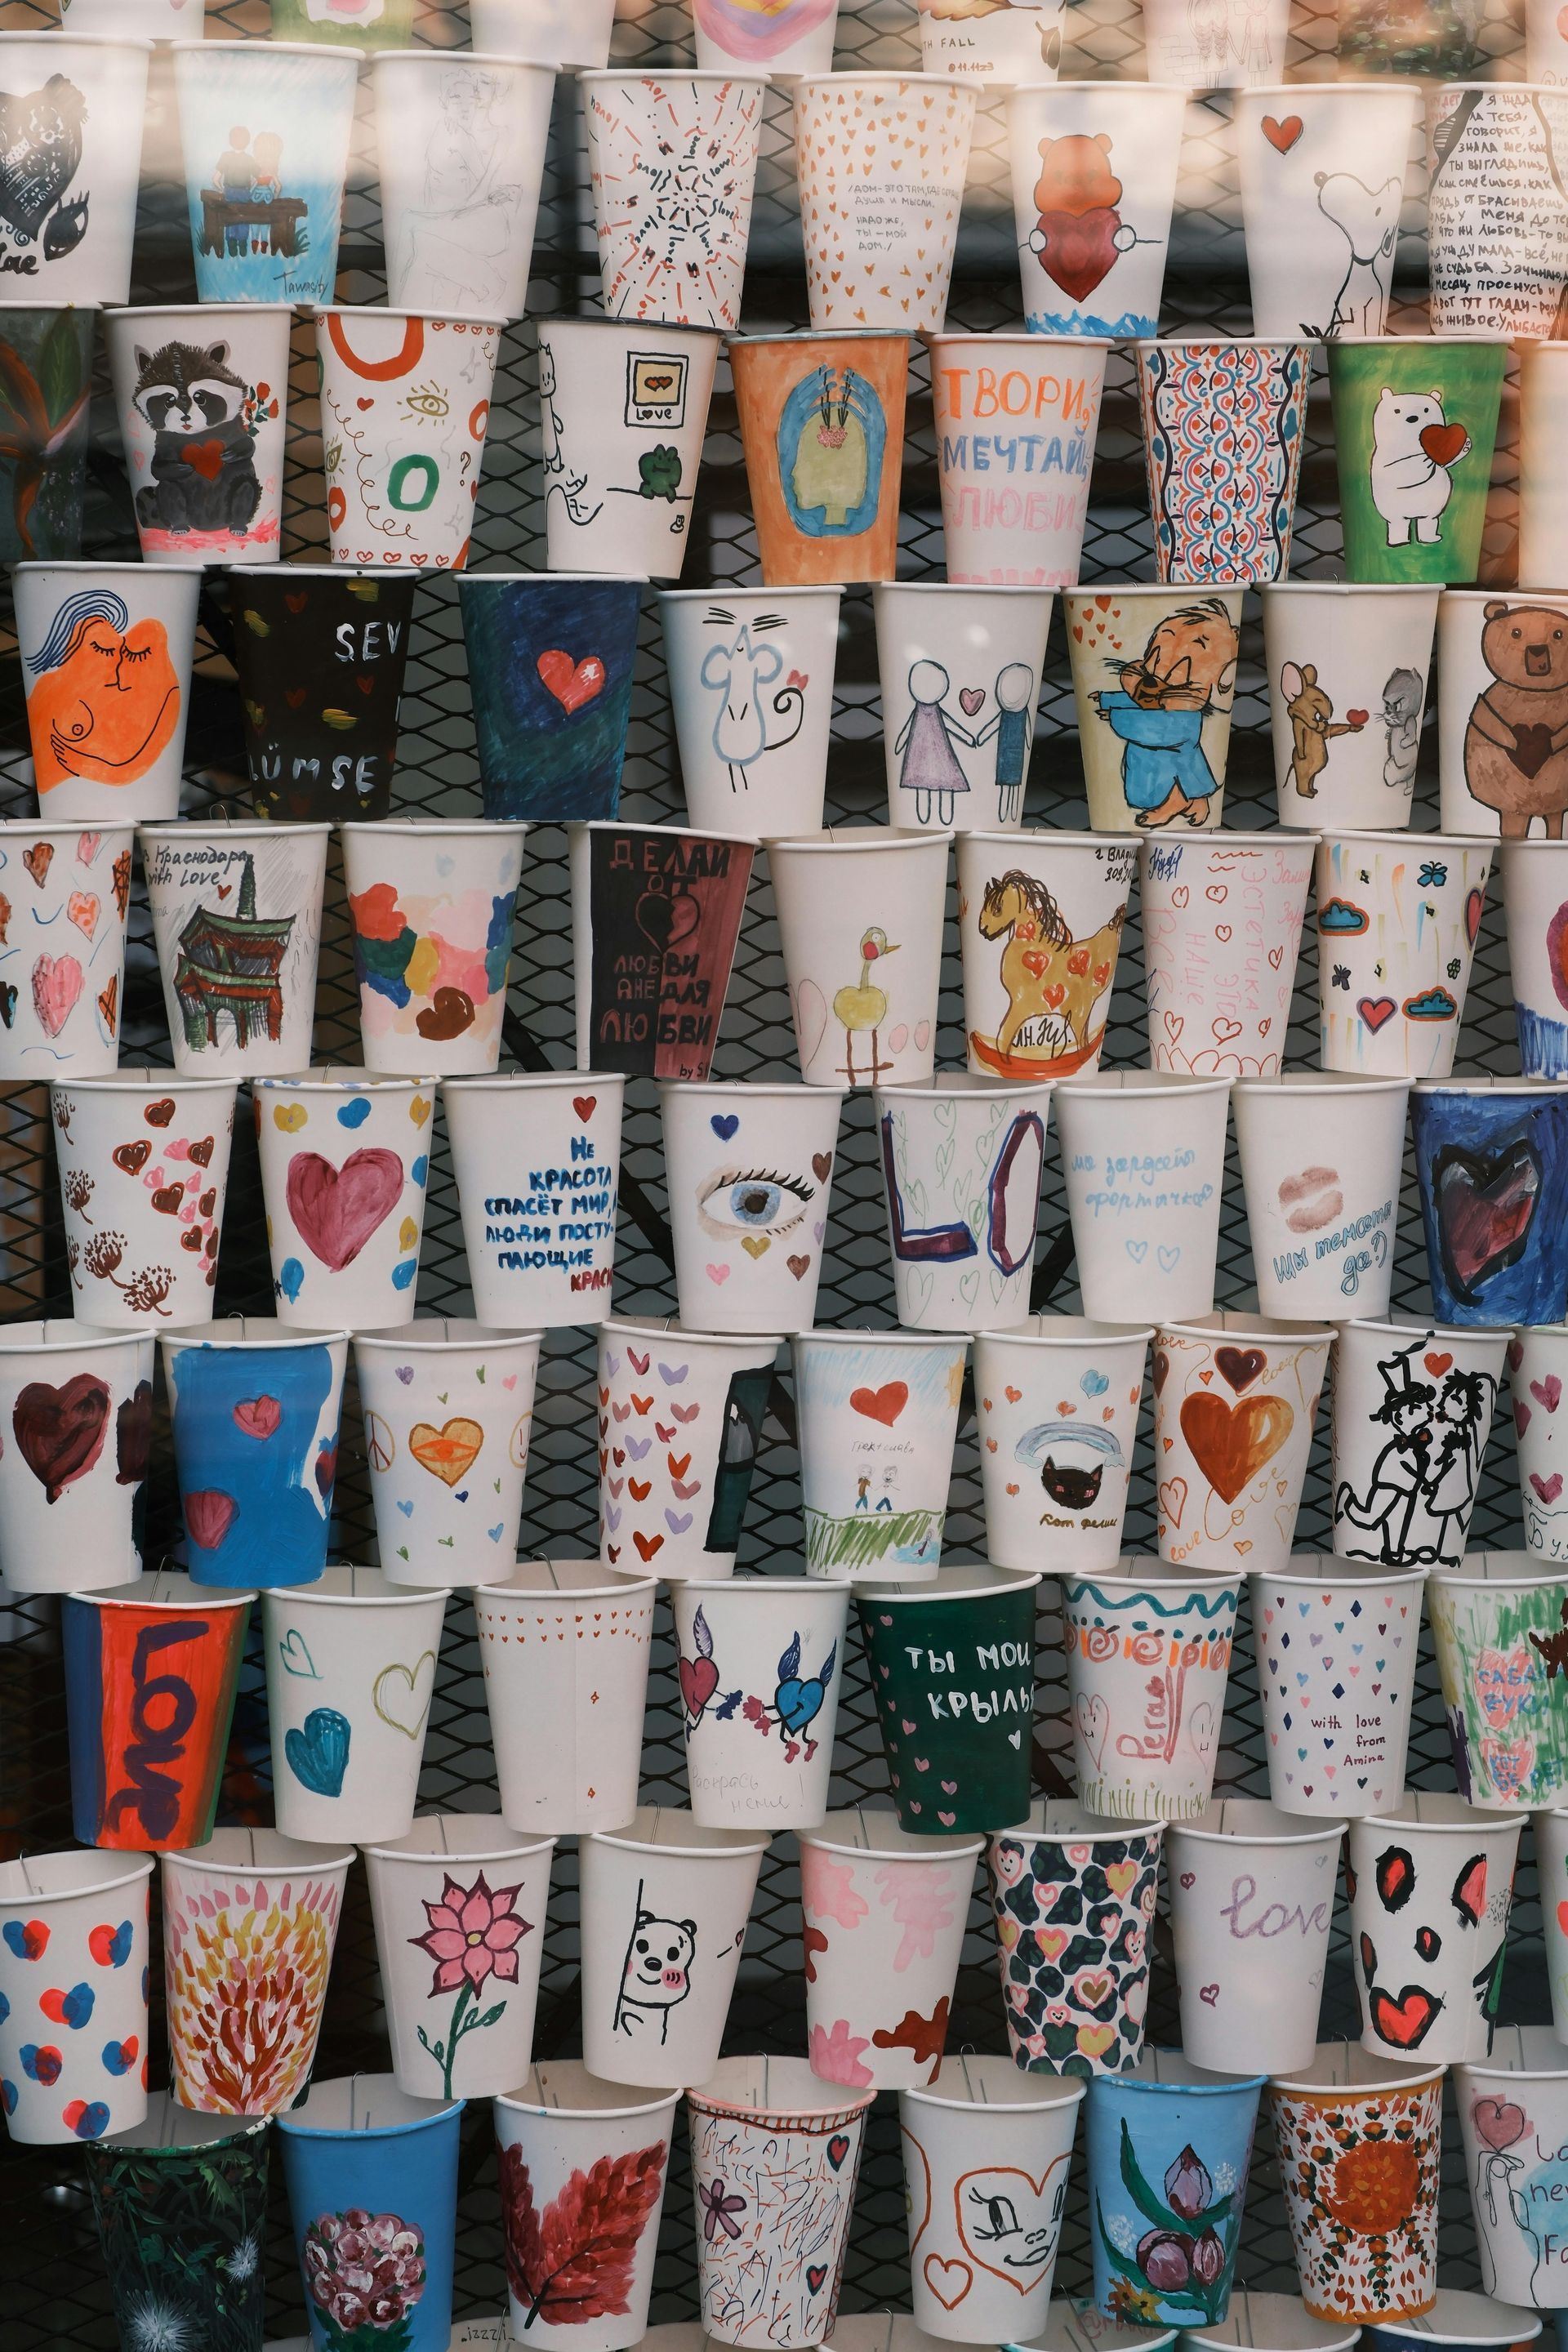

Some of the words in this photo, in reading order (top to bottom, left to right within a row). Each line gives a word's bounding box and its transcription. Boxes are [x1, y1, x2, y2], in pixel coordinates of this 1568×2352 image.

[941, 38, 975, 48] FALL
[1458, 141, 1498, 154] ЗНАЛА
[1449, 160, 1463, 172] ТЫ
[885, 185, 903, 193] ЭТО
[952, 486, 1078, 532] ЛЮБИ
[600, 1009, 713, 1045] ЛЮБВИ
[679, 1065, 693, 1079] by
[529, 1166, 612, 1192] КРАСОТА
[484, 1193, 563, 1216] СПАСЁТ
[486, 1224, 550, 1244] ЛЮДИ
[498, 1248, 593, 1274] ПАЮЩИЕ
[904, 1646, 956, 1673] ТЫ
[1311, 1715, 1342, 1729] with
[1356, 1713, 1381, 1728] love
[1356, 1735, 1386, 1747] from
[1343, 1754, 1384, 1766] Amina
[1220, 1873, 1332, 1938] love
